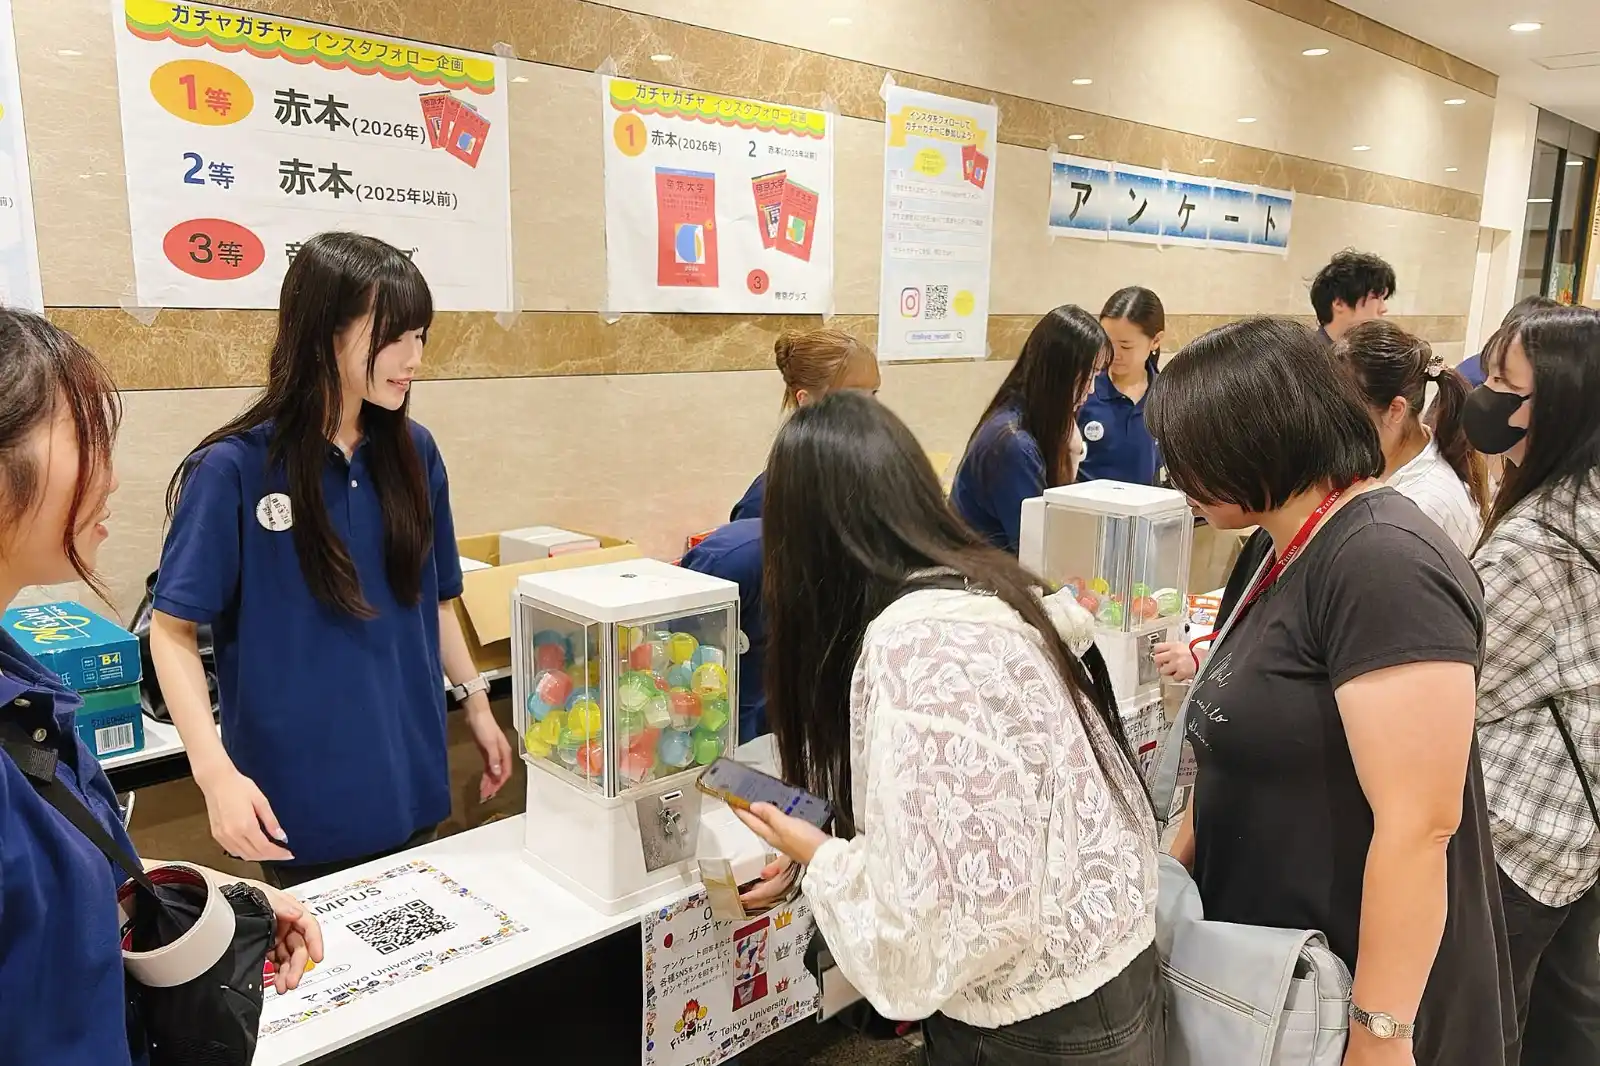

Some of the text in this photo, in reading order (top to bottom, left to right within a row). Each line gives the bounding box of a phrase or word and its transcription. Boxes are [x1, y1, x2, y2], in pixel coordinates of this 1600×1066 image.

[171, 4, 465, 73] ガチャガチャ インスタフォロー企画
[178, 74, 233, 117] 1等
[636, 84, 808, 124] ガチャガチャ インスタフォロー企画
[625, 124, 635, 147] 1
[651, 129, 722, 156] 赤本(2026年)
[748, 140, 757, 158] 2
[182, 152, 236, 191] 2等
[1069, 181, 1276, 242] アンケート
[188, 232, 244, 268] 3等
[753, 275, 763, 290] 3
[101, 653, 119, 666] B4
[324, 975, 370, 996] Teikyo
[370, 949, 434, 978] University
[670, 1018, 712, 1050] Fight!
[720, 996, 789, 1037] Teikyo University
